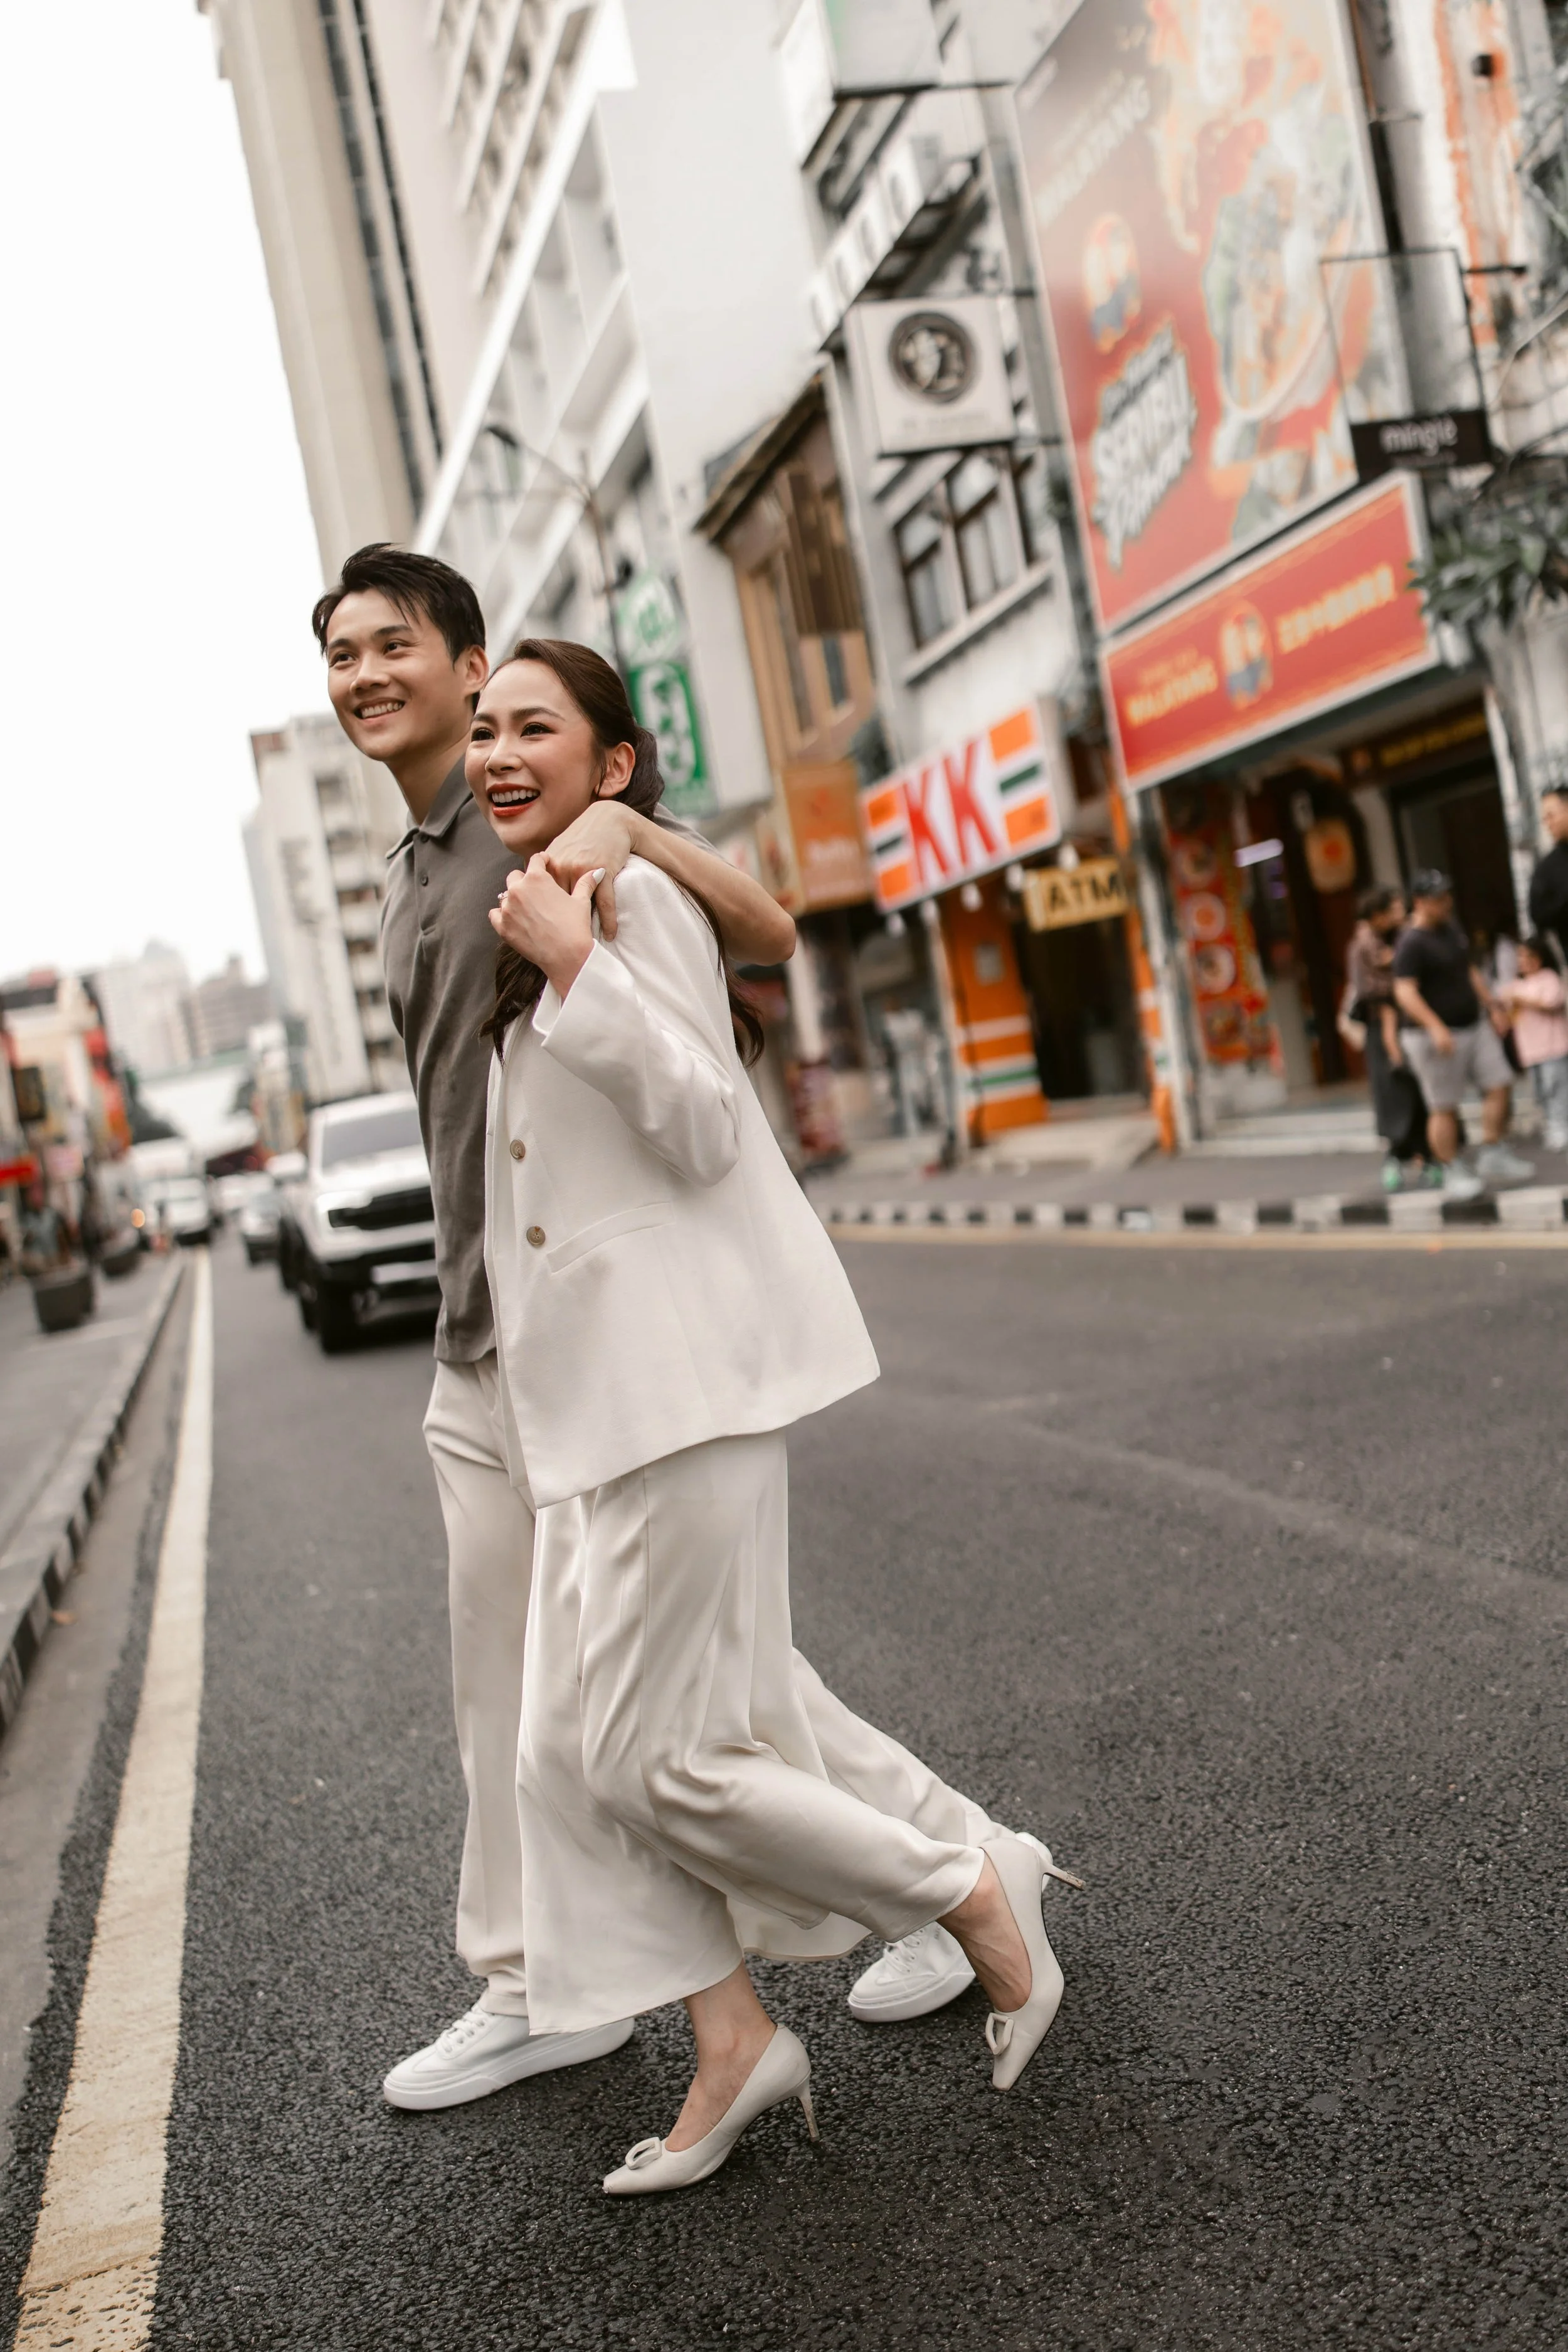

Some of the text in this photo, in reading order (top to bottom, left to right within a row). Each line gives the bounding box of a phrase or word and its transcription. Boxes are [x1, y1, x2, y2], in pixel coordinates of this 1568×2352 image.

[1381, 416, 1458, 457] mingle
[903, 740, 996, 884] KK
[1049, 876, 1125, 911] ATM
